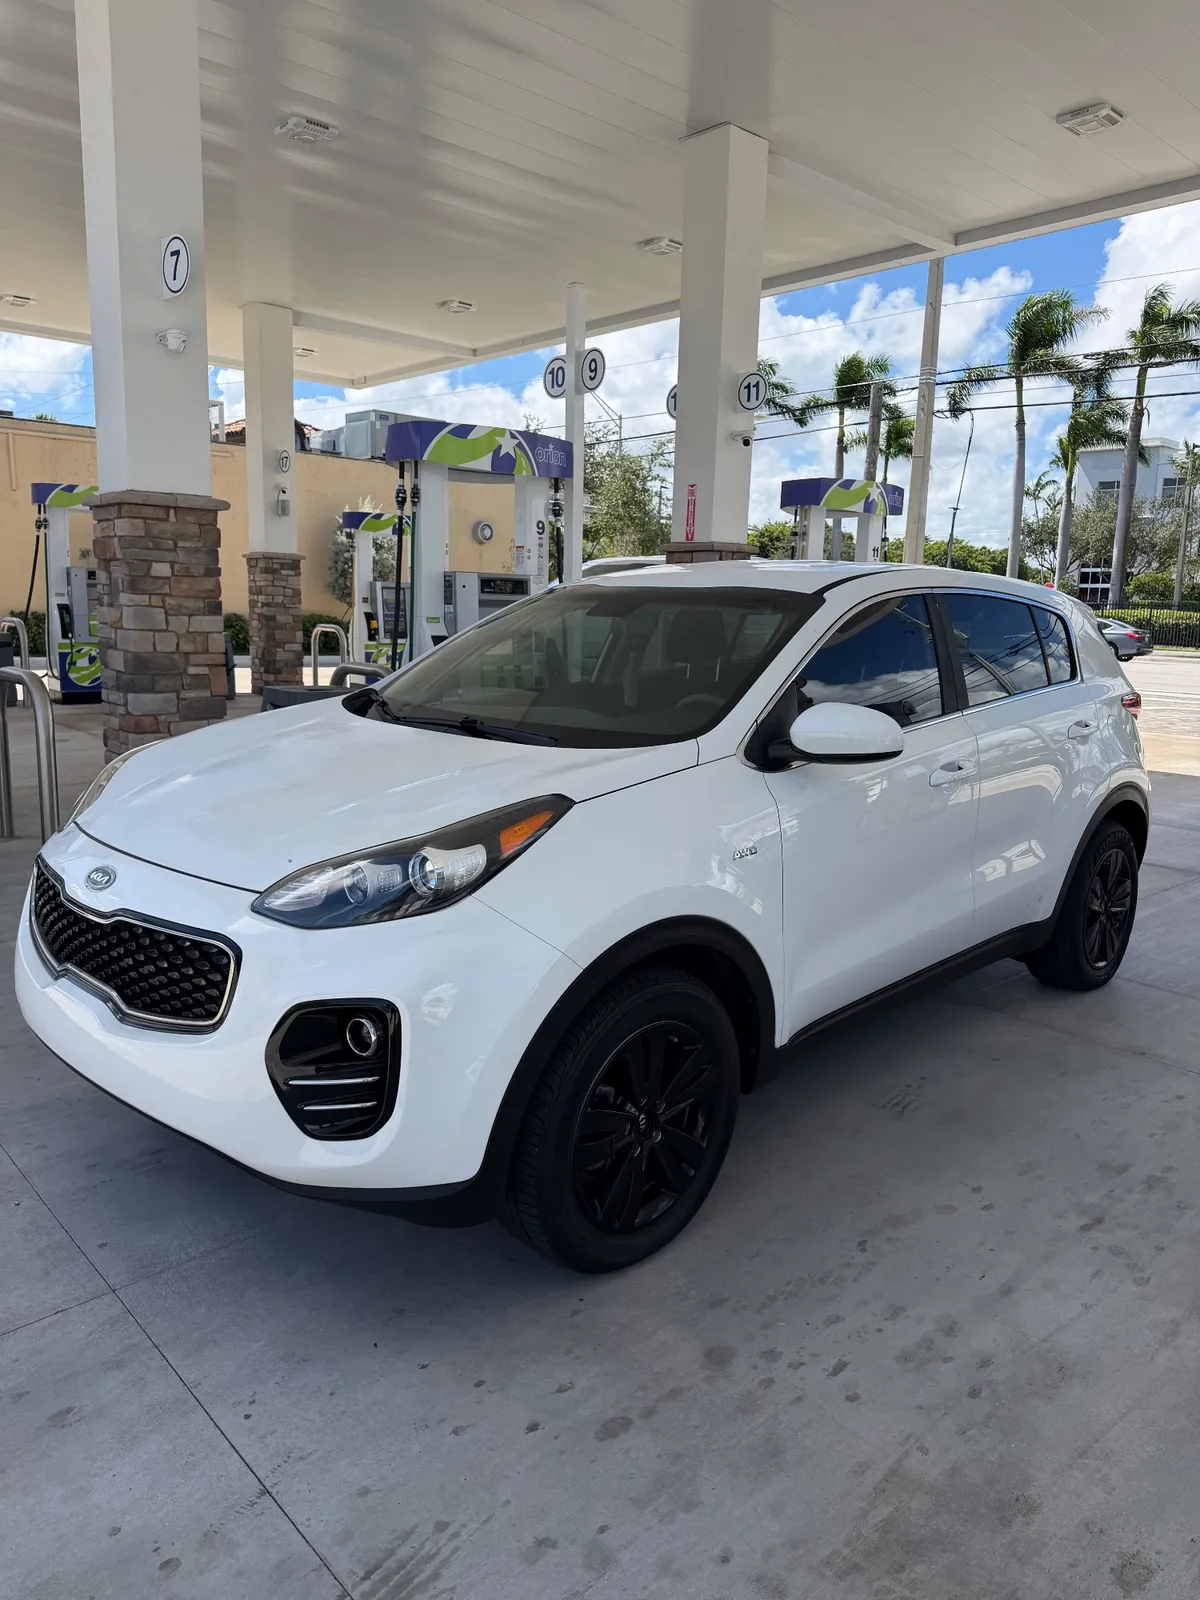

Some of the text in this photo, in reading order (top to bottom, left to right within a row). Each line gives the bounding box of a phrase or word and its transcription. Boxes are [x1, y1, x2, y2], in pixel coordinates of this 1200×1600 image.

[170, 249, 181, 281] 7
[548, 366, 565, 389] 10
[588, 358, 597, 381] 9
[743, 380, 760, 402] 11
[281, 456, 288, 468] 17
[534, 442, 566, 467] orion
[536, 520, 545, 535] 9
[872, 546, 879, 558] 11
[733, 846, 758, 861] AWD
